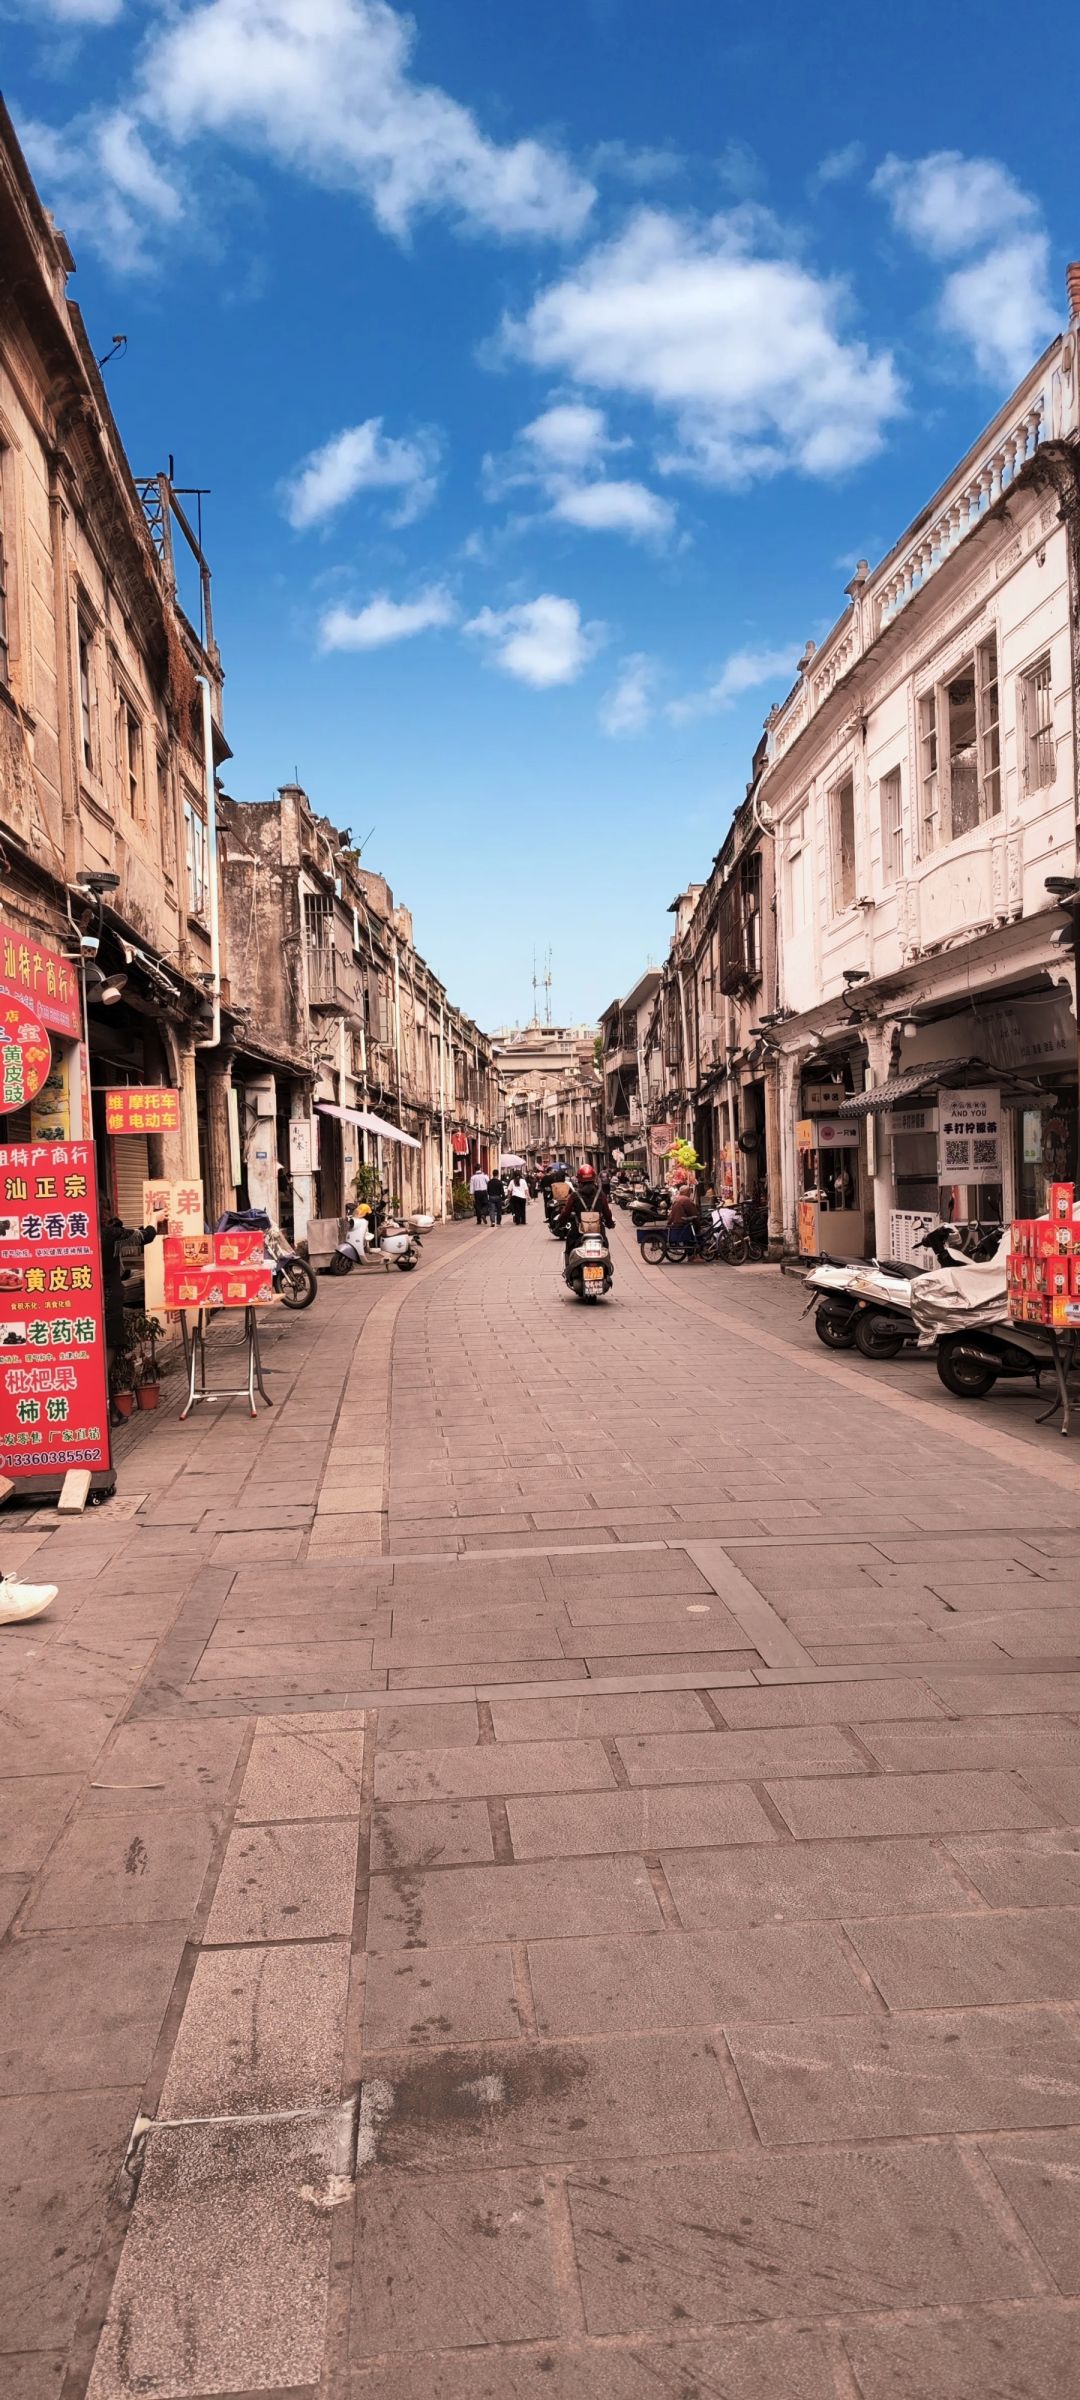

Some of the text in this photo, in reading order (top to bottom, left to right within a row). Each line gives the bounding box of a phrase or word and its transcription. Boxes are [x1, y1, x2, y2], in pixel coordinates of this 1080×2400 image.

[3, 1045, 23, 1103] 黄皮豉
[109, 1093, 176, 1110] 维 摩托车
[109, 1112, 176, 1129] 修 电动车
[971, 1109, 986, 1117] YOU
[944, 1121, 997, 1134] 手打柠檬茶
[22, 1213, 88, 1240] 老香黄
[25, 1265, 93, 1293] 黄皮豉
[28, 1317, 95, 1346] 老药桔
[5, 1367, 77, 1394] 枇杷果
[17, 1398, 69, 1423] 柿饼
[0, 1427, 100, 1446] 发零售 厂家直销
[6, 1449, 100, 1466] 13360385562
